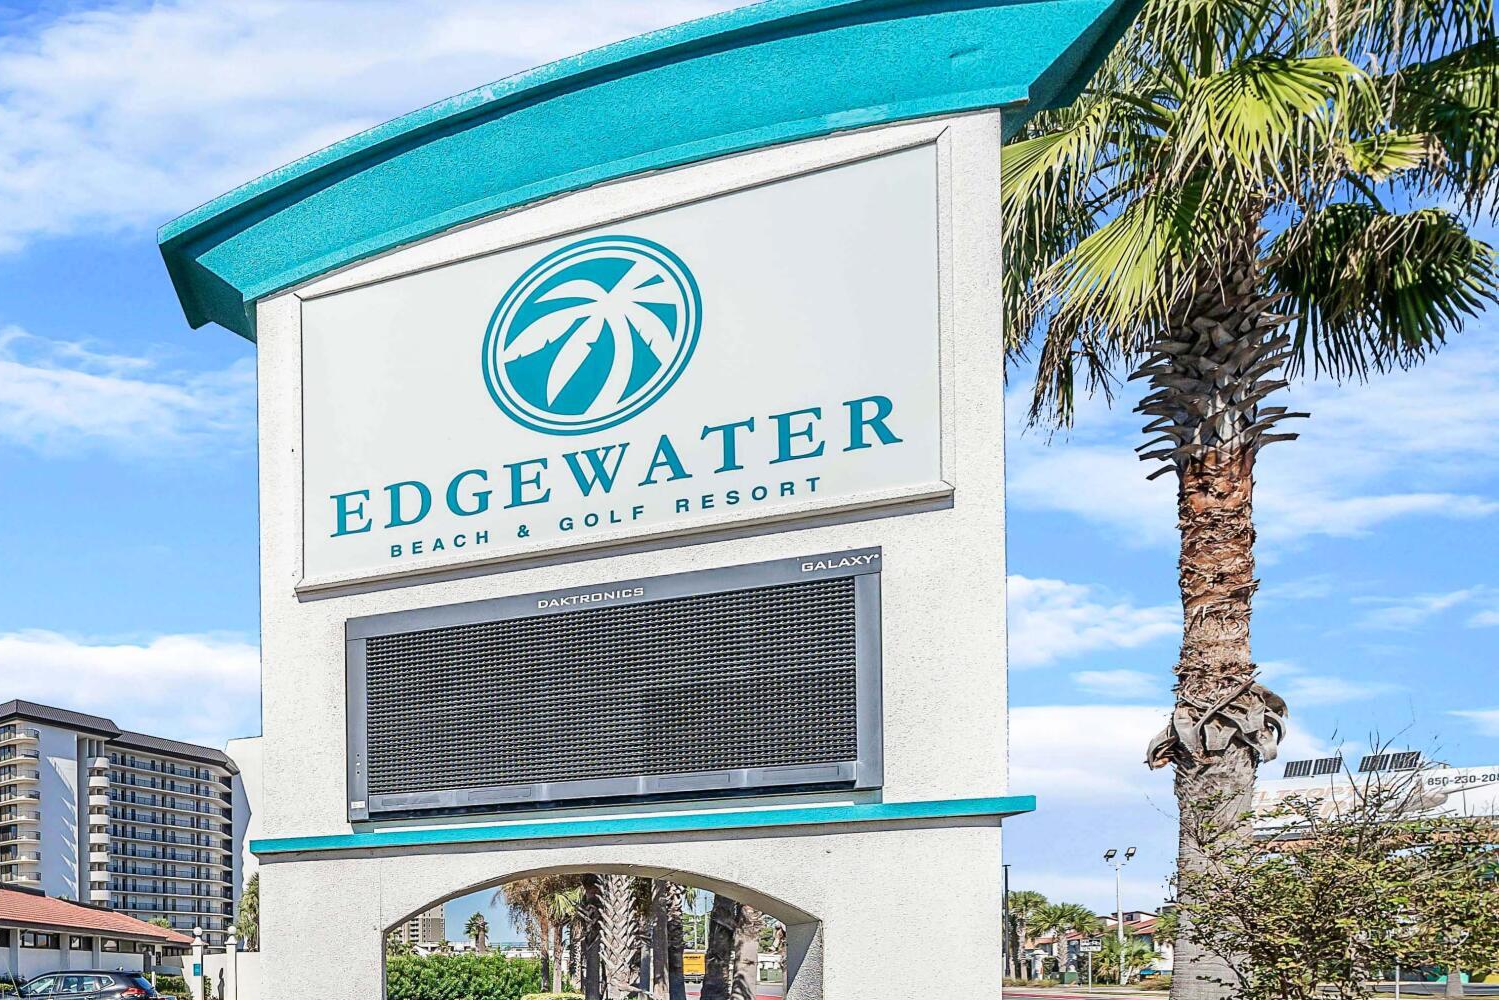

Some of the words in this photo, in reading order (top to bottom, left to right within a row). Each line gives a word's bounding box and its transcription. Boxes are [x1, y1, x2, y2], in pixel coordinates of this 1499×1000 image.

[329, 395, 904, 538] EDGEWATER
[390, 530, 489, 558] BEACH
[516, 524, 530, 538] &
[558, 505, 645, 531] GOLF
[675, 476, 821, 514] RESORT
[537, 587, 644, 609] DAKTRONICS
